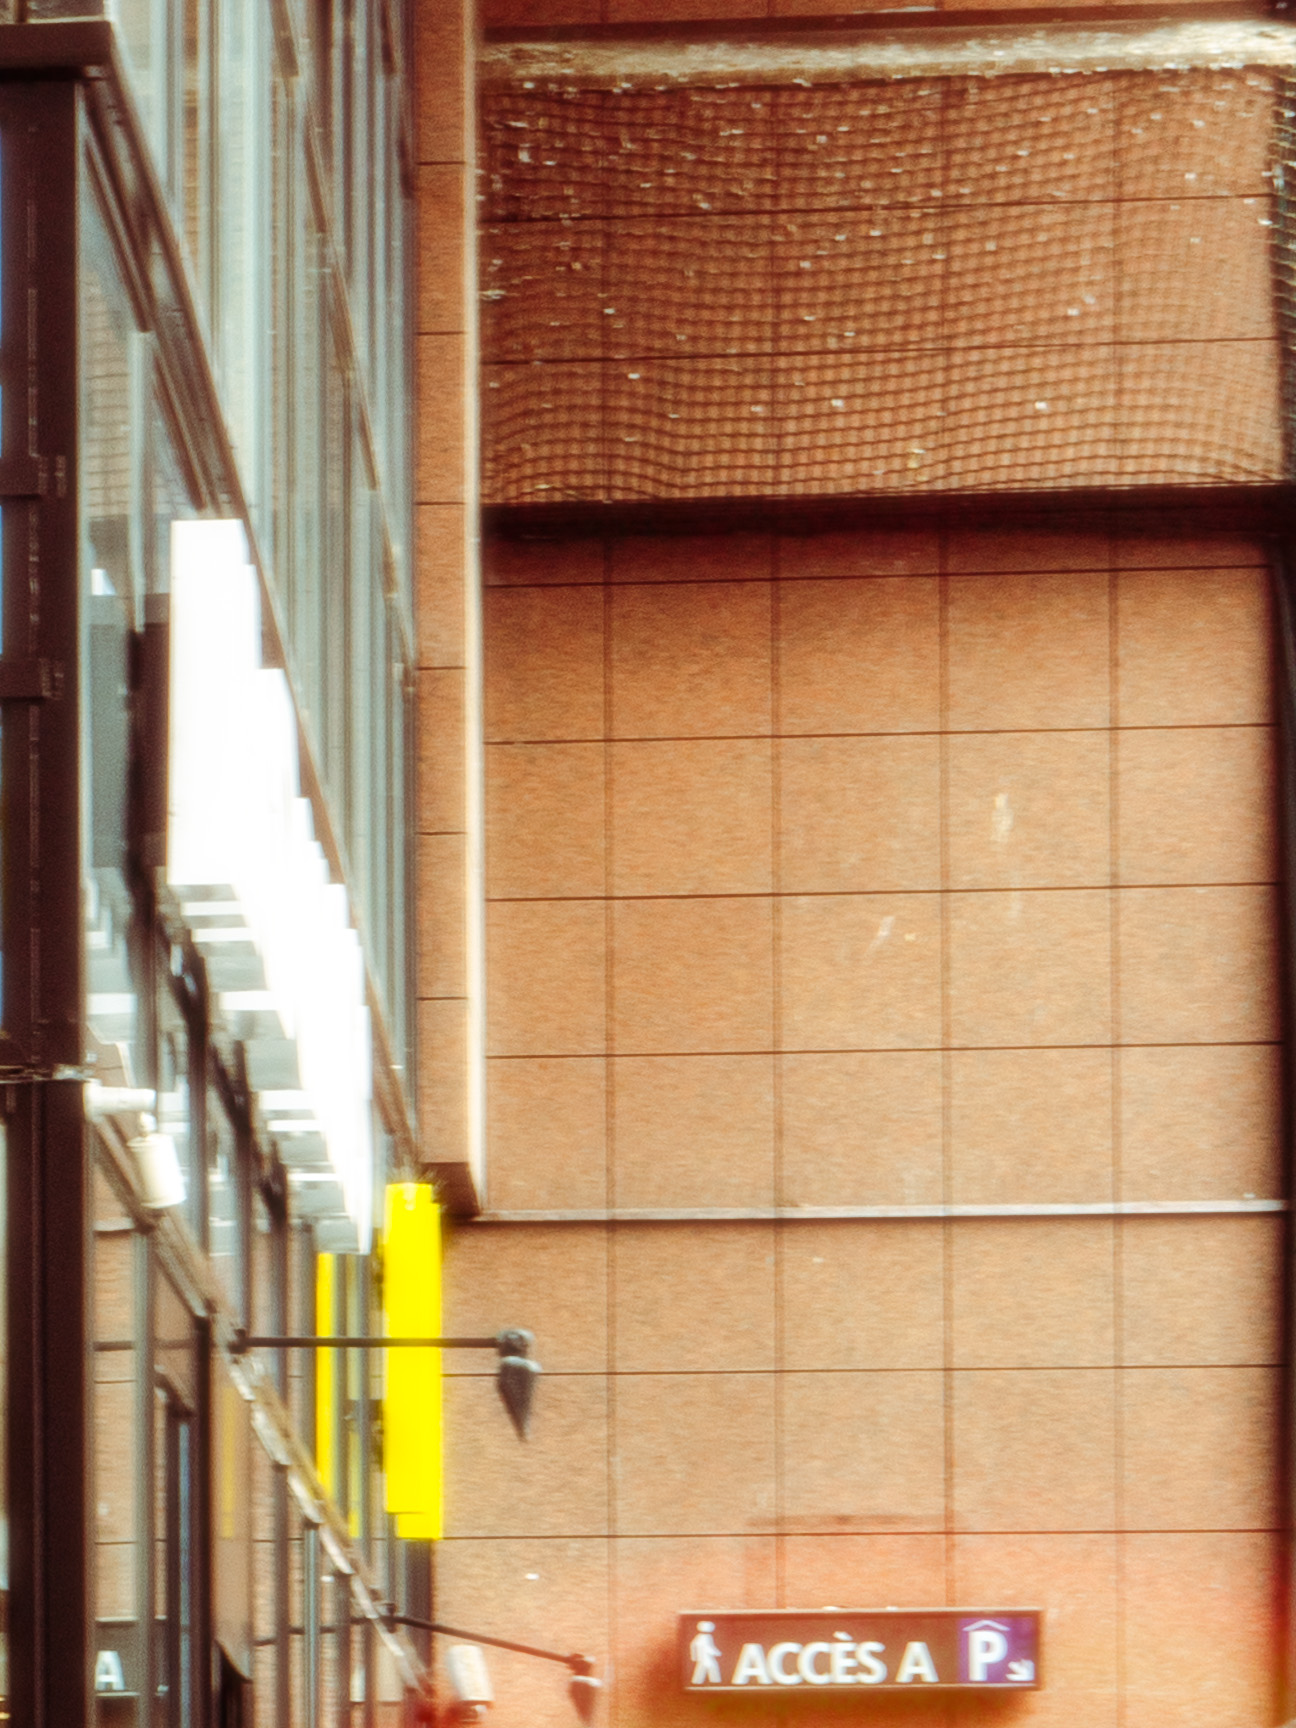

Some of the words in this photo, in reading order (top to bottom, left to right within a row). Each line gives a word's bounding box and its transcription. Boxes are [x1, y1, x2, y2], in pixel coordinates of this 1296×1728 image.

[732, 1631, 886, 1685] ACCÈS
[895, 1642, 939, 1684] A
[970, 1631, 1007, 1682] P
